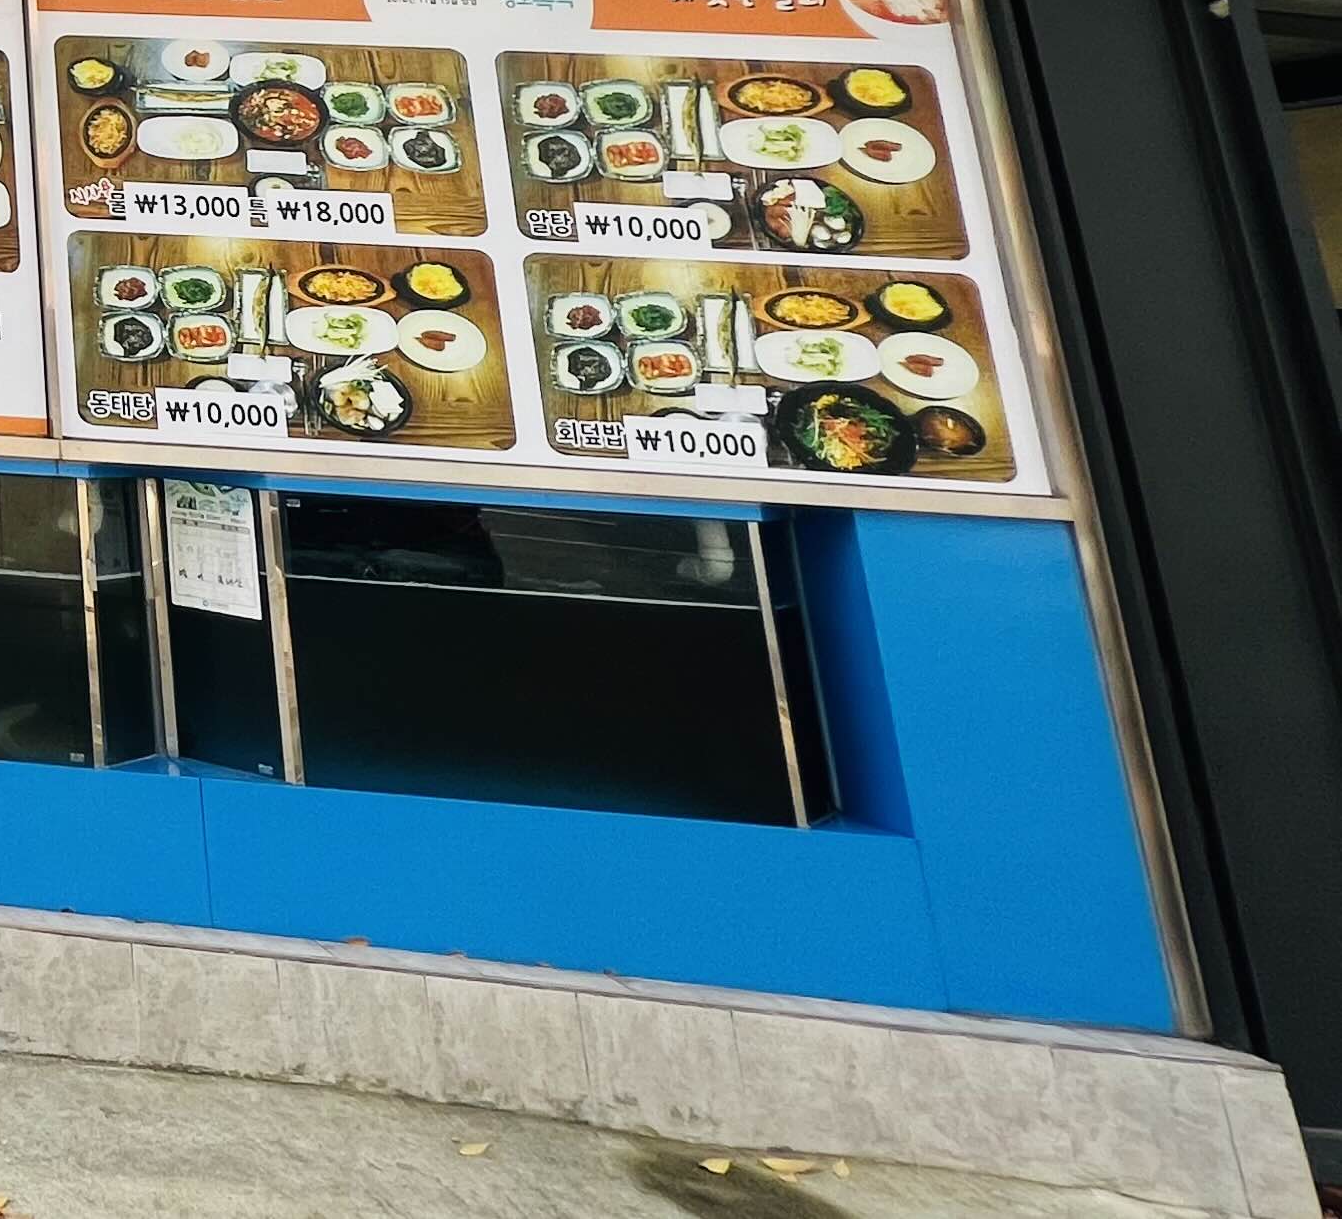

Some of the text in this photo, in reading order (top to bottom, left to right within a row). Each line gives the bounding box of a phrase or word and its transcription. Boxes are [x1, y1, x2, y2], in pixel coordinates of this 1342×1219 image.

[134, 192, 241, 220] ₩13,000
[276, 199, 385, 226] ₩18,000
[525, 210, 704, 246] 알탕 ₩10,000
[87, 389, 280, 429] 동태탕 ₩10,000
[556, 417, 757, 460] 회덮밥 ₩10,000
